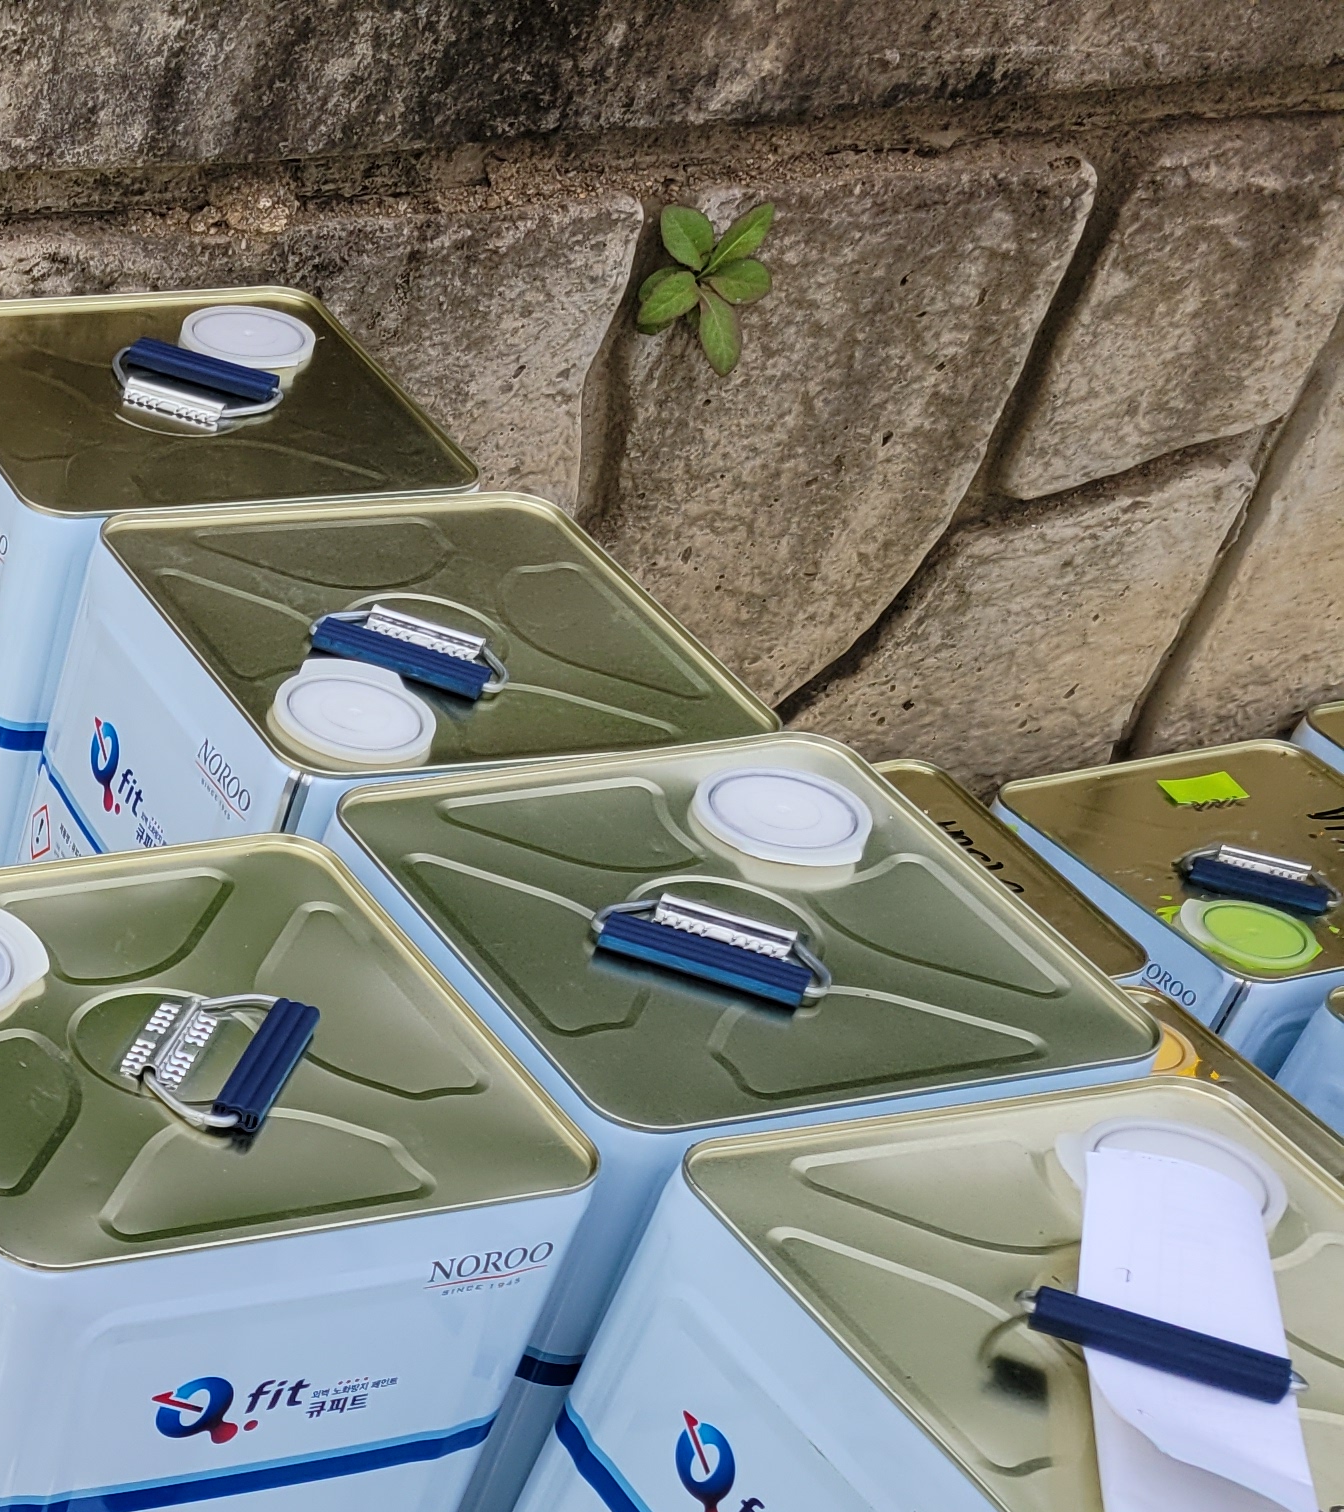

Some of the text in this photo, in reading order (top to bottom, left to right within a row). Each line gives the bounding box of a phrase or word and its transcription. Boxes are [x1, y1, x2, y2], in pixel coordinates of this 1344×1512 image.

[196, 738, 251, 812] NOROO
[1146, 958, 1197, 1006] OROO
[427, 1242, 554, 1283] NOROO
[441, 1284, 483, 1296] SINCE
[244, 1378, 311, 1414] fit
[306, 1394, 368, 1419] 큐피트
